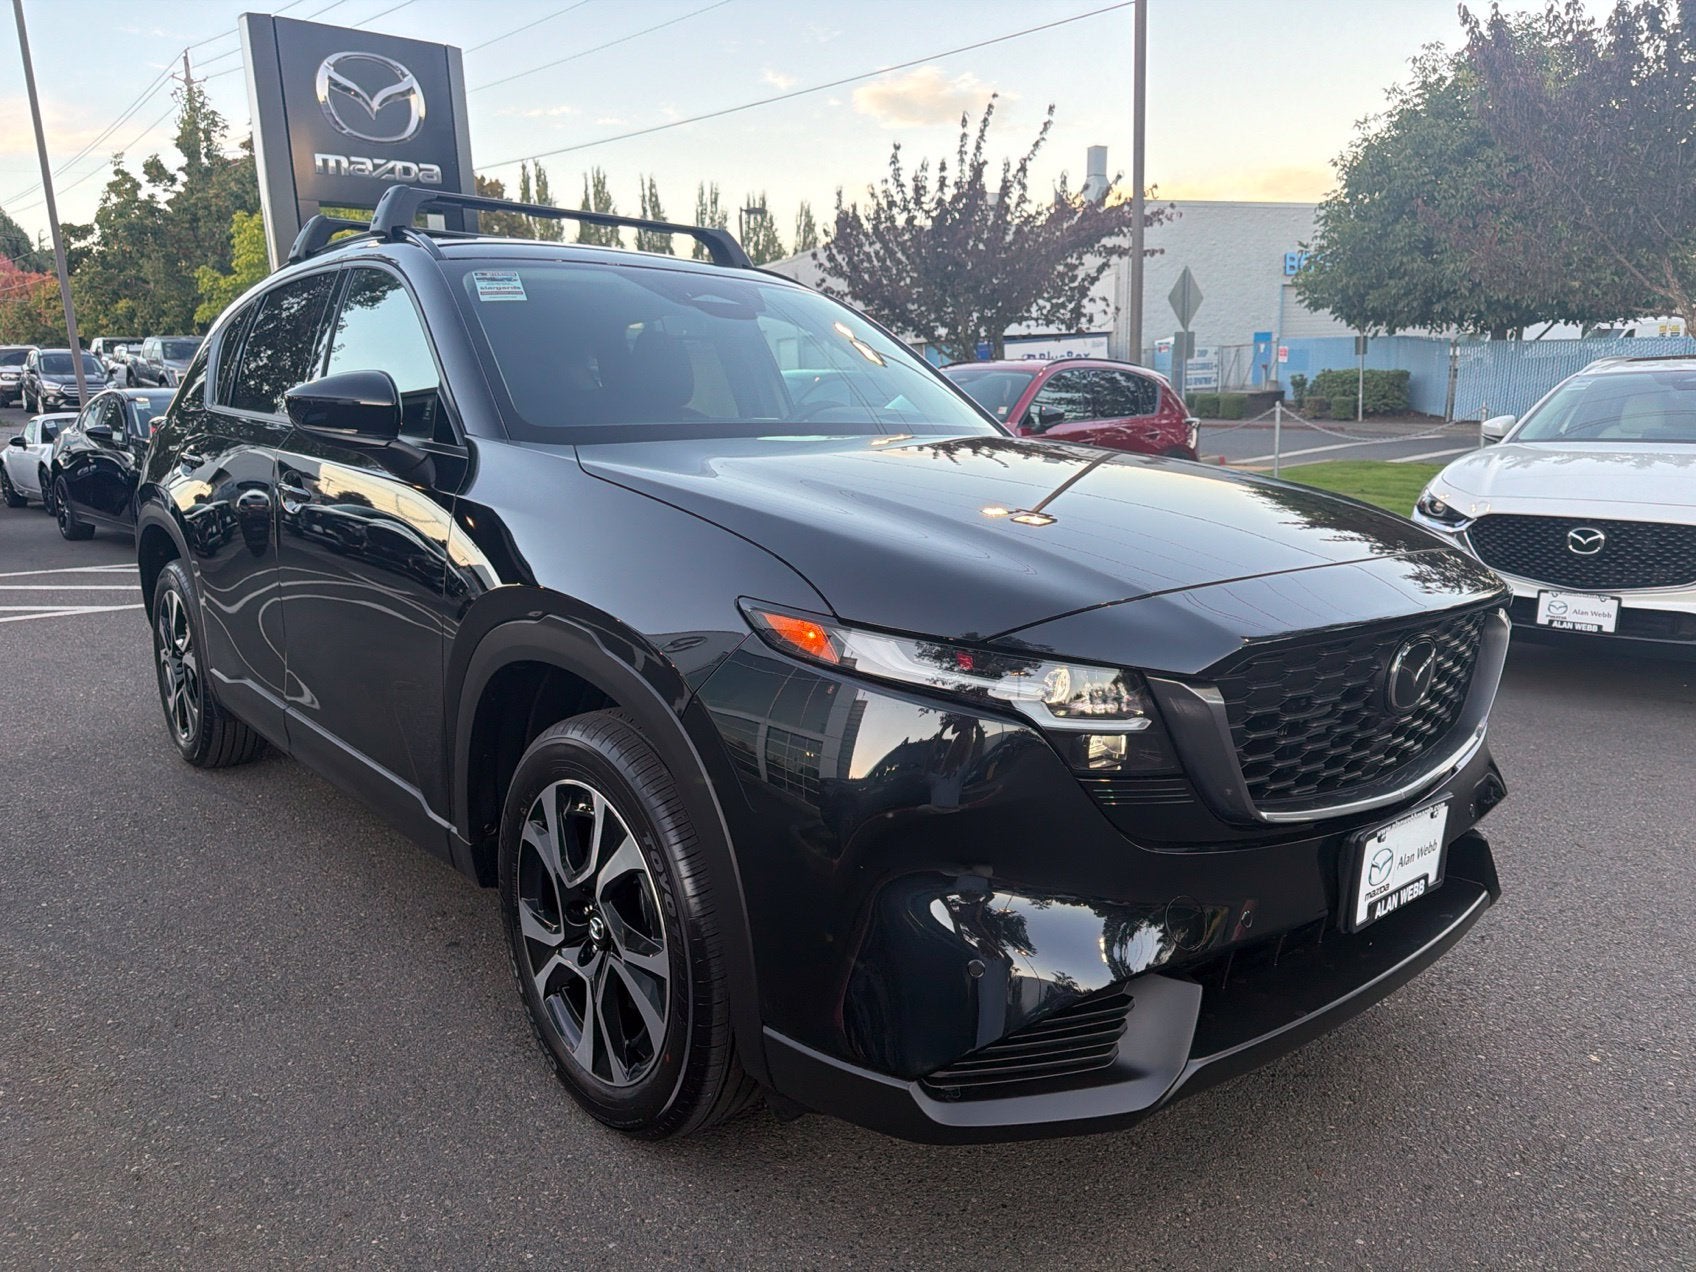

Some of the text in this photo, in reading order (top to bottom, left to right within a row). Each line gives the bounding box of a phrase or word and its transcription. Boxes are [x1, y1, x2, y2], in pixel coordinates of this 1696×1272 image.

[314, 153, 442, 184] mazda
[1552, 620, 1598, 632] ALAN WEBB
[1397, 840, 1438, 870] Alan Webb
[642, 831, 677, 917] TOYO
[1364, 884, 1390, 901] mazda
[1374, 880, 1425, 920] ALAN WEBB
